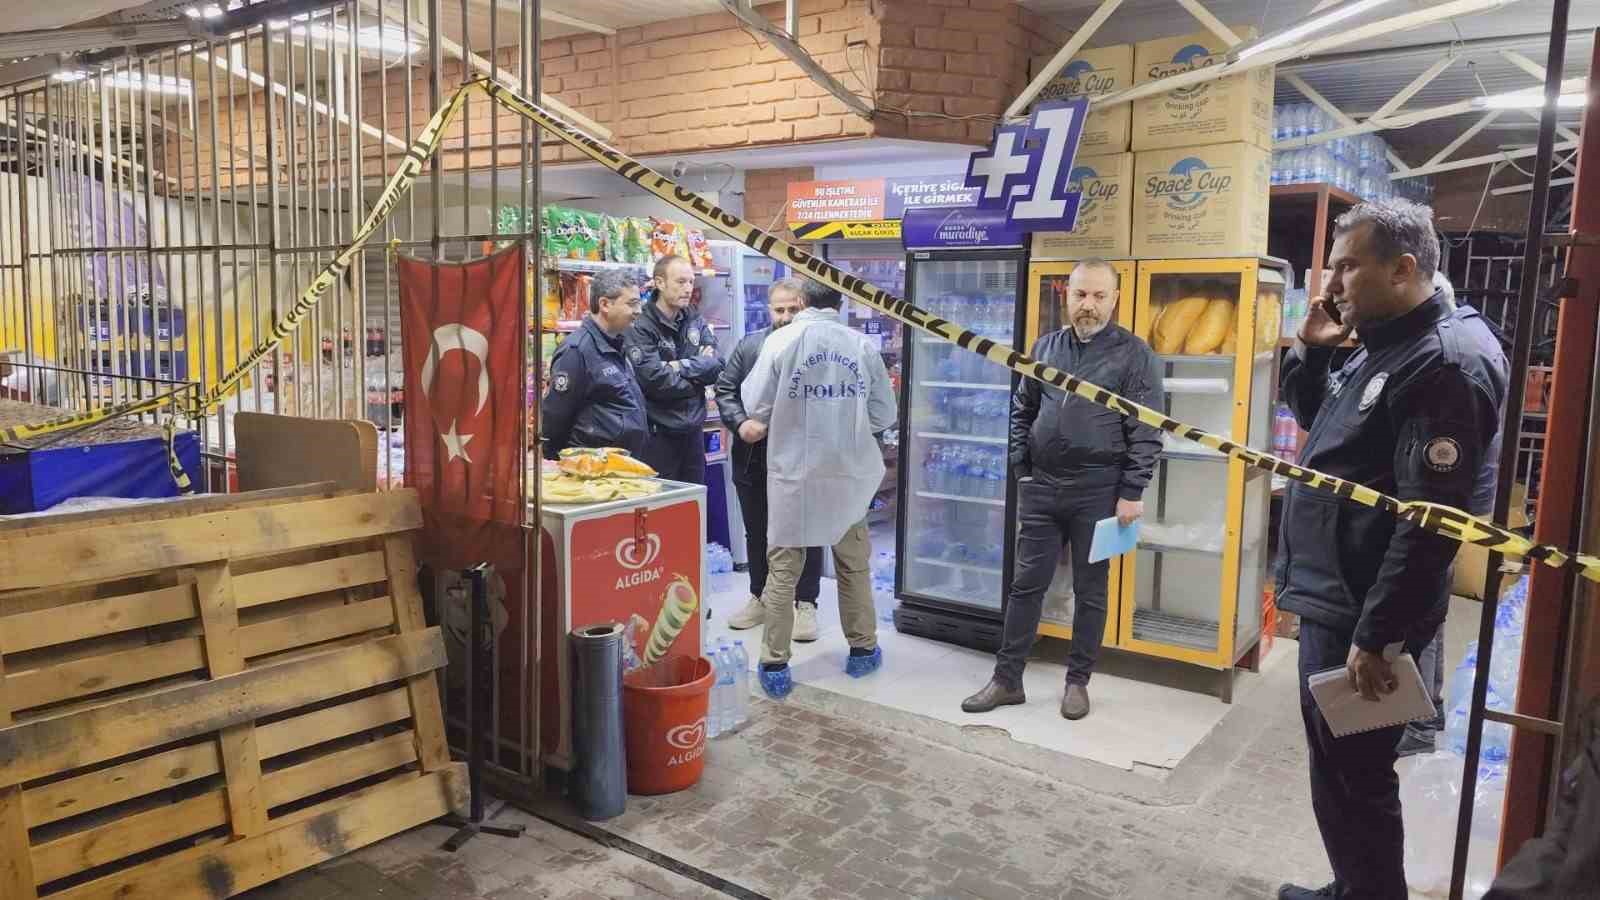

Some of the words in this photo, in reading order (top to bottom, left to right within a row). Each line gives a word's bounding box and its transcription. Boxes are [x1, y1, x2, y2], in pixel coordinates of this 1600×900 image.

[1085, 74, 1114, 95] Cup
[971, 108, 1074, 219] +1
[1088, 180, 1119, 201] Cup
[1145, 175, 1193, 199] Space
[1198, 171, 1232, 194] Cup
[903, 195, 921, 206] İLE
[922, 192, 974, 206] GİRMEK
[804, 381, 856, 398] POLİS
[615, 568, 661, 590] ALGIDA
